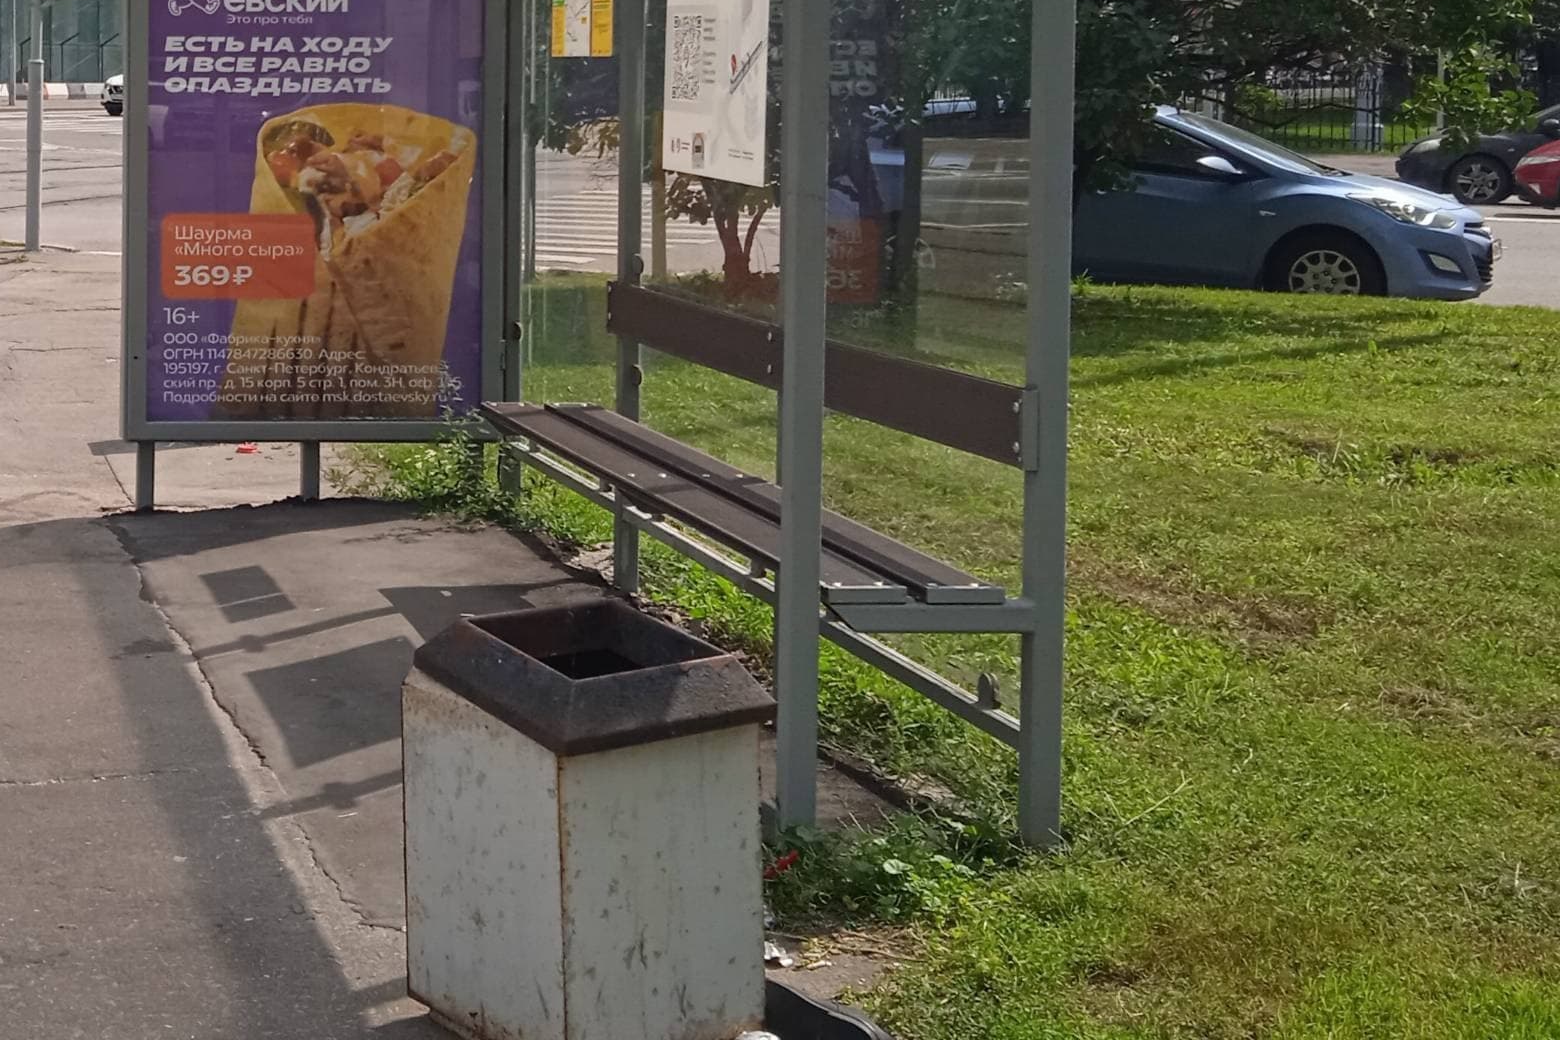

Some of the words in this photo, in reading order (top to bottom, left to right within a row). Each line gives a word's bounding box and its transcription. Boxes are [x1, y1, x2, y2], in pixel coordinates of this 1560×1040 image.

[226, 15, 251, 25] Это
[253, 15, 280, 27] про
[282, 14, 313, 25] тебя
[164, 36, 246, 53] ЕСТЬ
[249, 36, 295, 53] НА
[299, 36, 394, 57] ХОДУ
[164, 56, 189, 73] И
[192, 56, 257, 73] ВСЕ
[260, 56, 371, 74] РАВНО
[163, 76, 393, 97] ОПАЗДЫВАТЬ
[174, 225, 252, 244] Шаурма
[174, 241, 245, 257] «Много
[248, 244, 305, 260] сыра»
[162, 306, 200, 326] 16+
[163, 332, 198, 345] ООО
[163, 347, 204, 361] ОГРН
[163, 376, 196, 389] ский
[240, 376, 254, 389] 15
[296, 376, 306, 389] 5
[163, 390, 257, 406] Подробности
[260, 393, 277, 403] на
[280, 391, 320, 403] сайте
